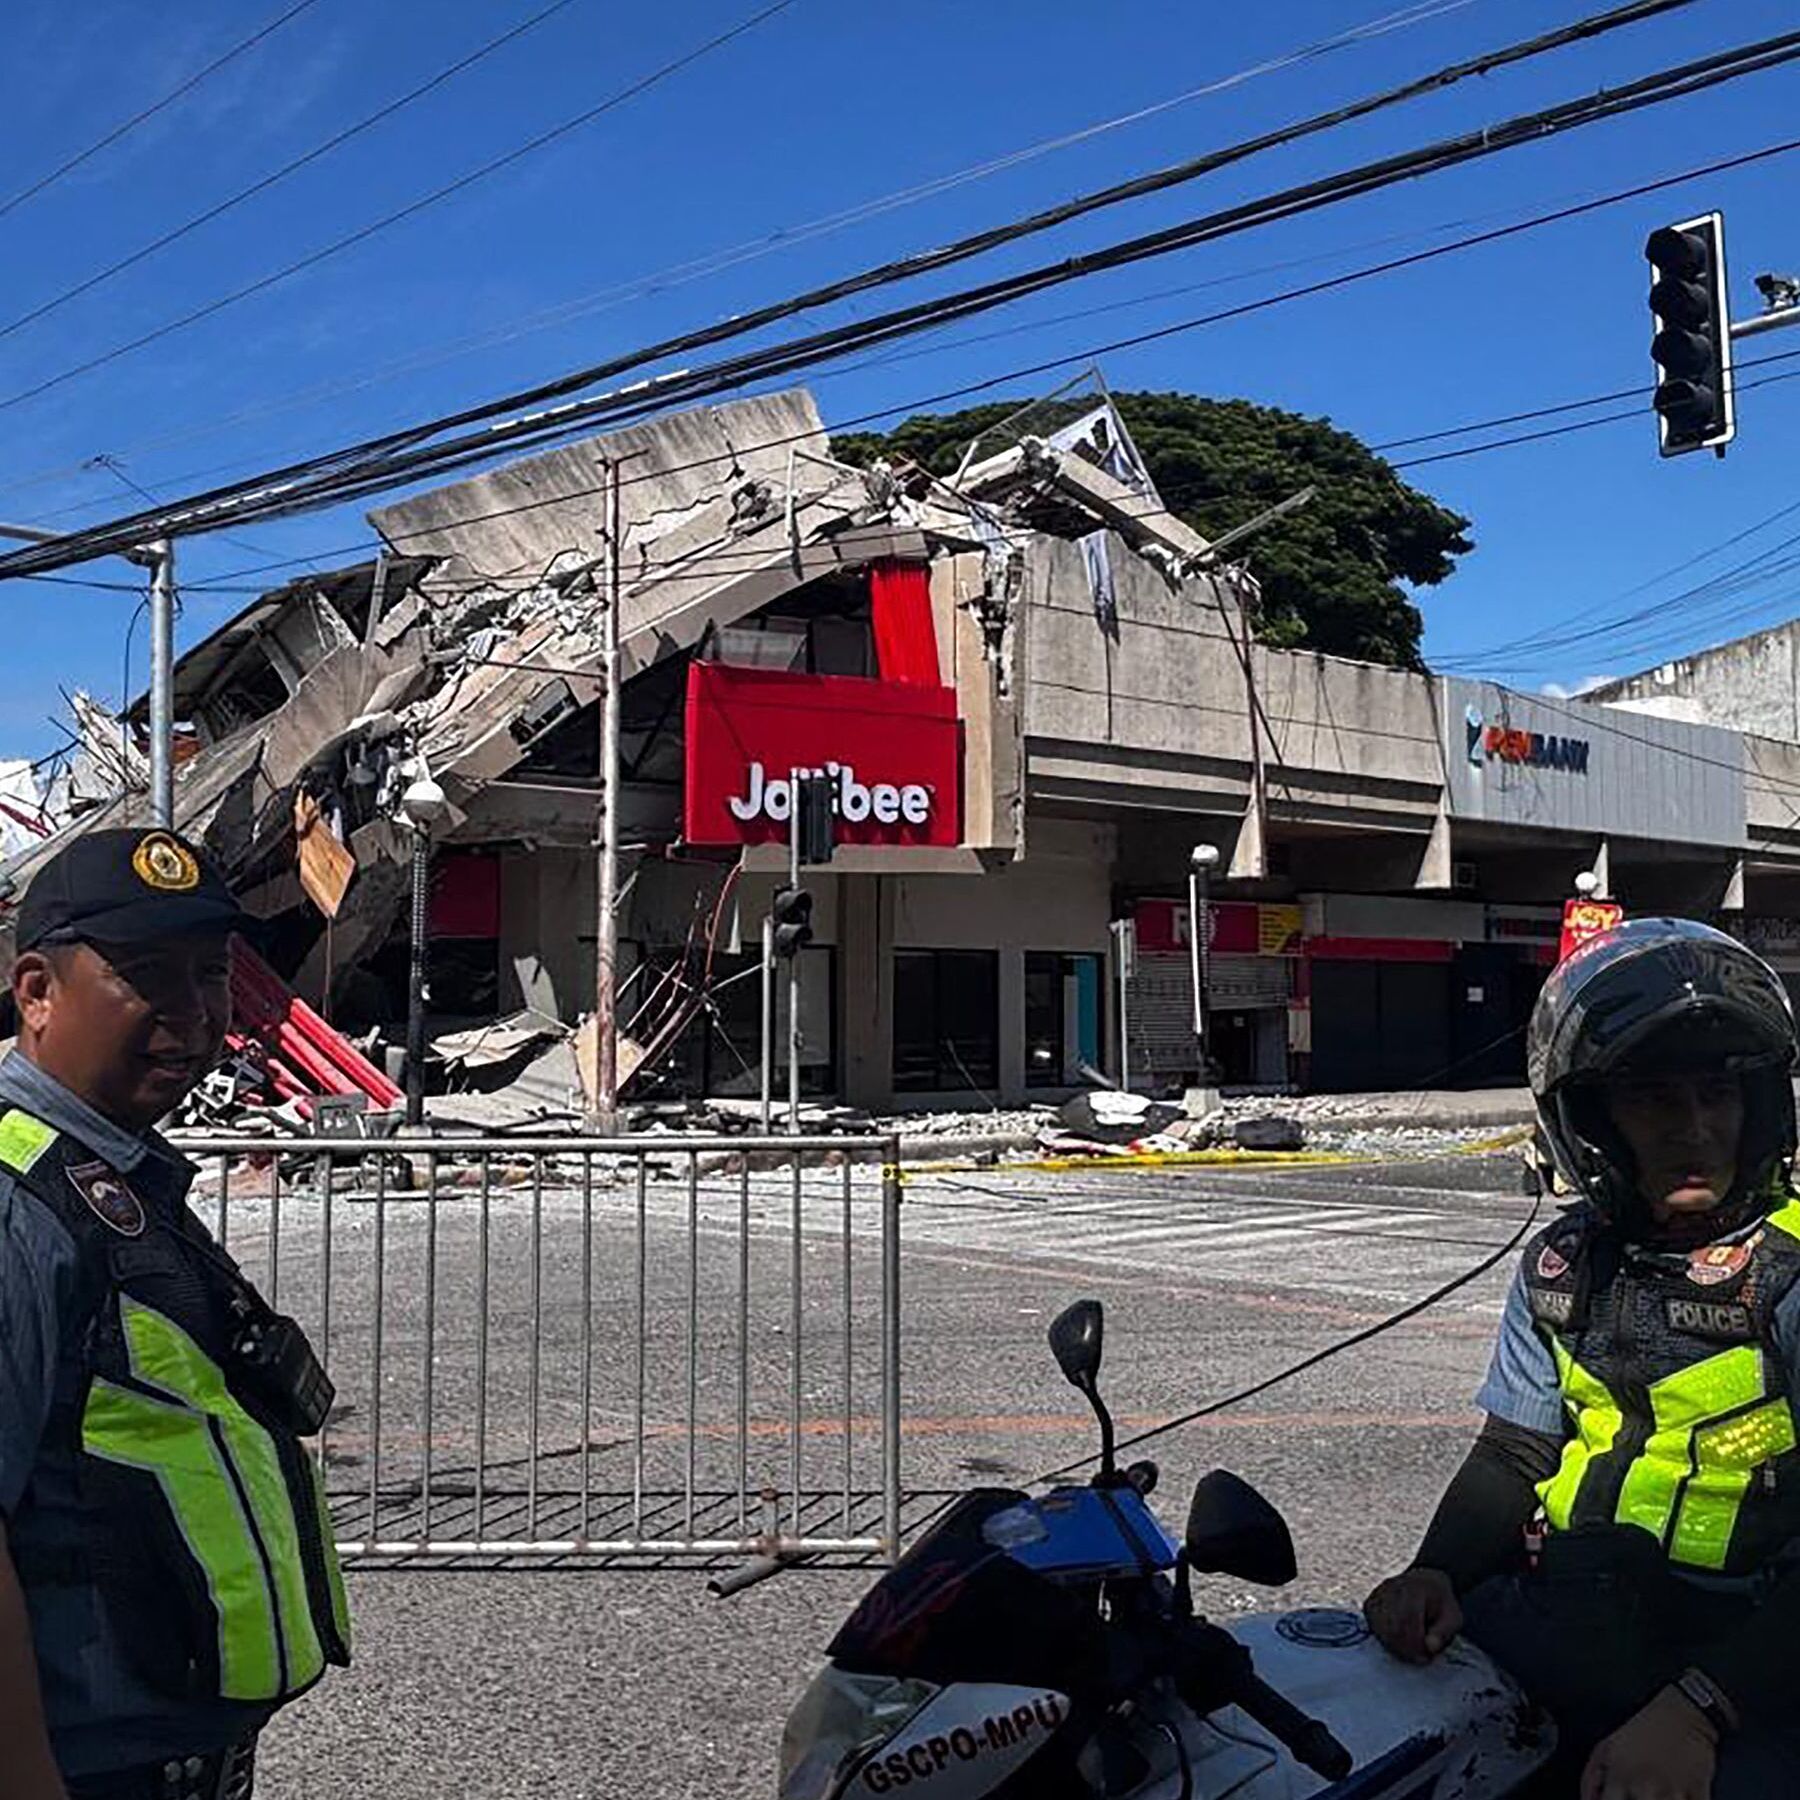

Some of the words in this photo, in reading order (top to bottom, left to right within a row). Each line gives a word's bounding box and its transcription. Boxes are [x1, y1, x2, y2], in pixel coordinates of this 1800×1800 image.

[731, 762, 929, 823] Joibee
[1669, 1299, 1748, 1332] POLICE
[862, 1694, 1062, 1794] GSCPO-MPU
